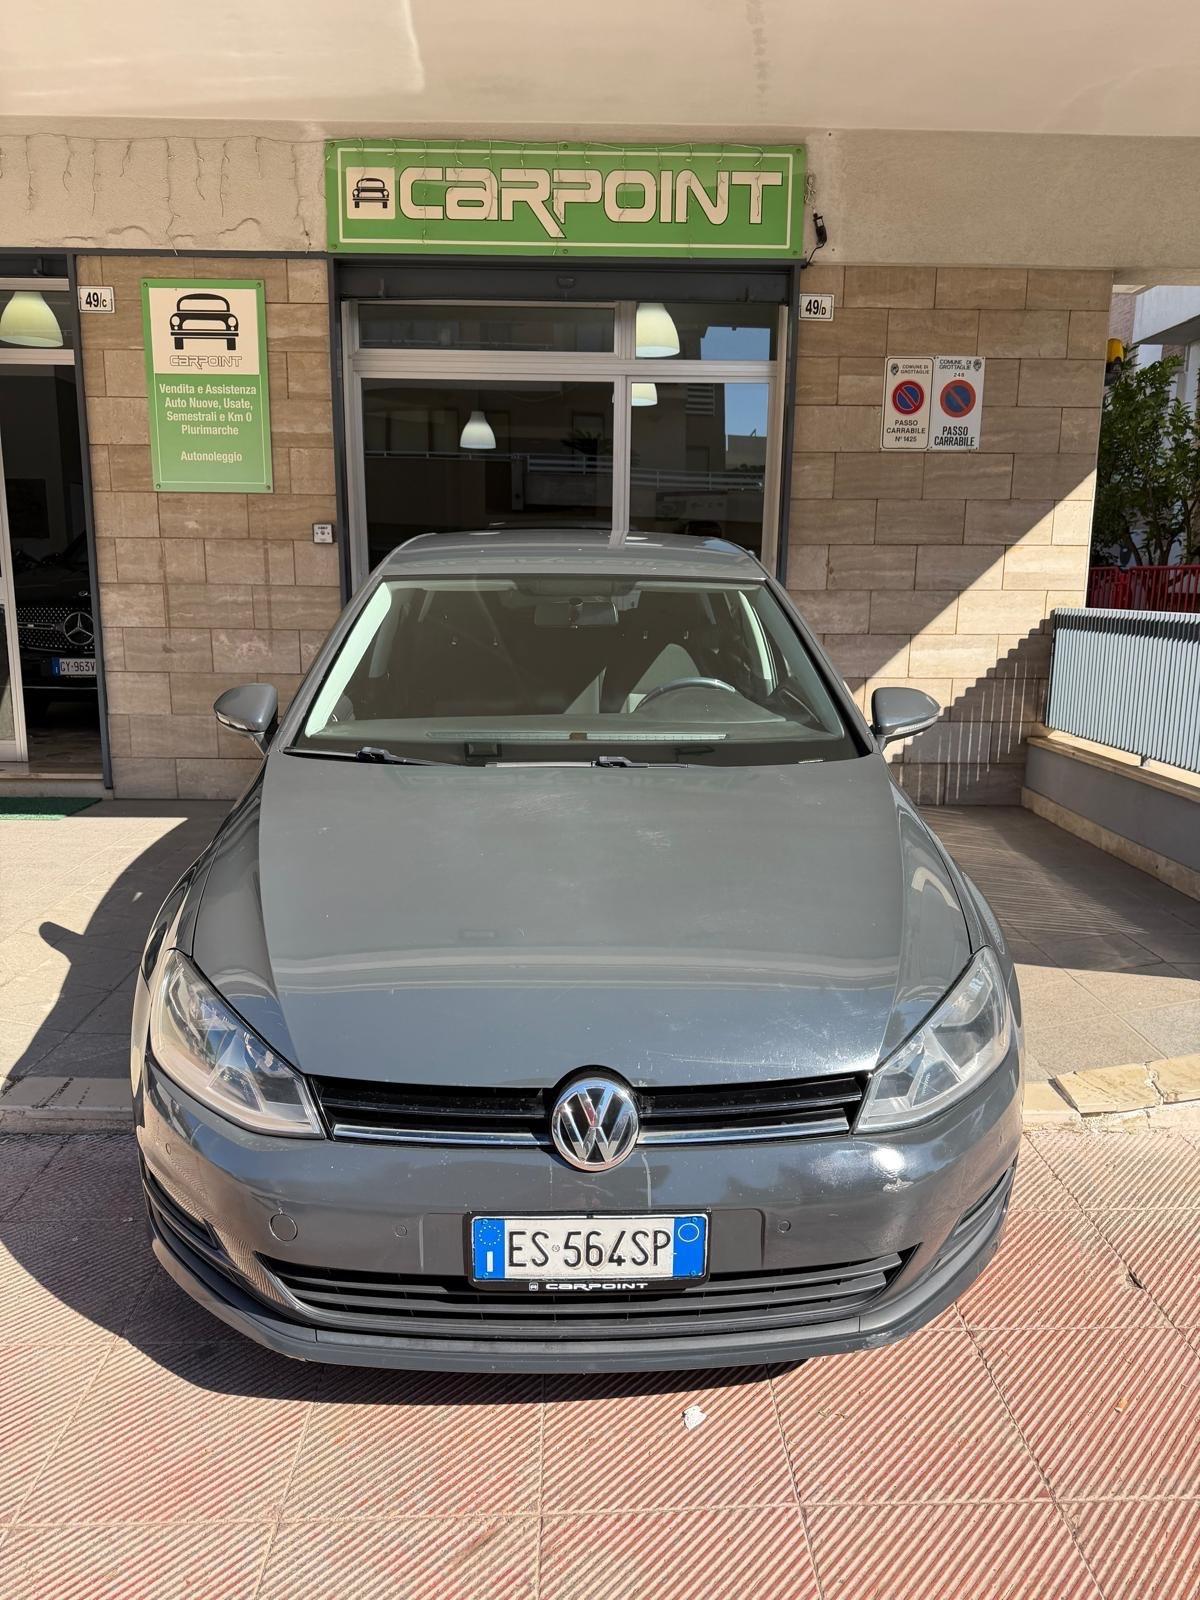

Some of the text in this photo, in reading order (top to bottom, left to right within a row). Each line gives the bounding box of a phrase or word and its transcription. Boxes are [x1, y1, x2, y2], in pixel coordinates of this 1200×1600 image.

[159, 383, 257, 395] Vendita e Assistenza
[165, 397, 253, 411] Auto Nuove, Usate,
[166, 410, 252, 422] Semestrali e Km 0
[181, 424, 239, 435] Plurimarche
[942, 425, 969, 436] PASSO
[934, 435, 976, 447] CARRABILE
[180, 451, 243, 464] Autonoleggio
[508, 1230, 550, 1268] ES
[563, 1230, 672, 1268] 564SP
